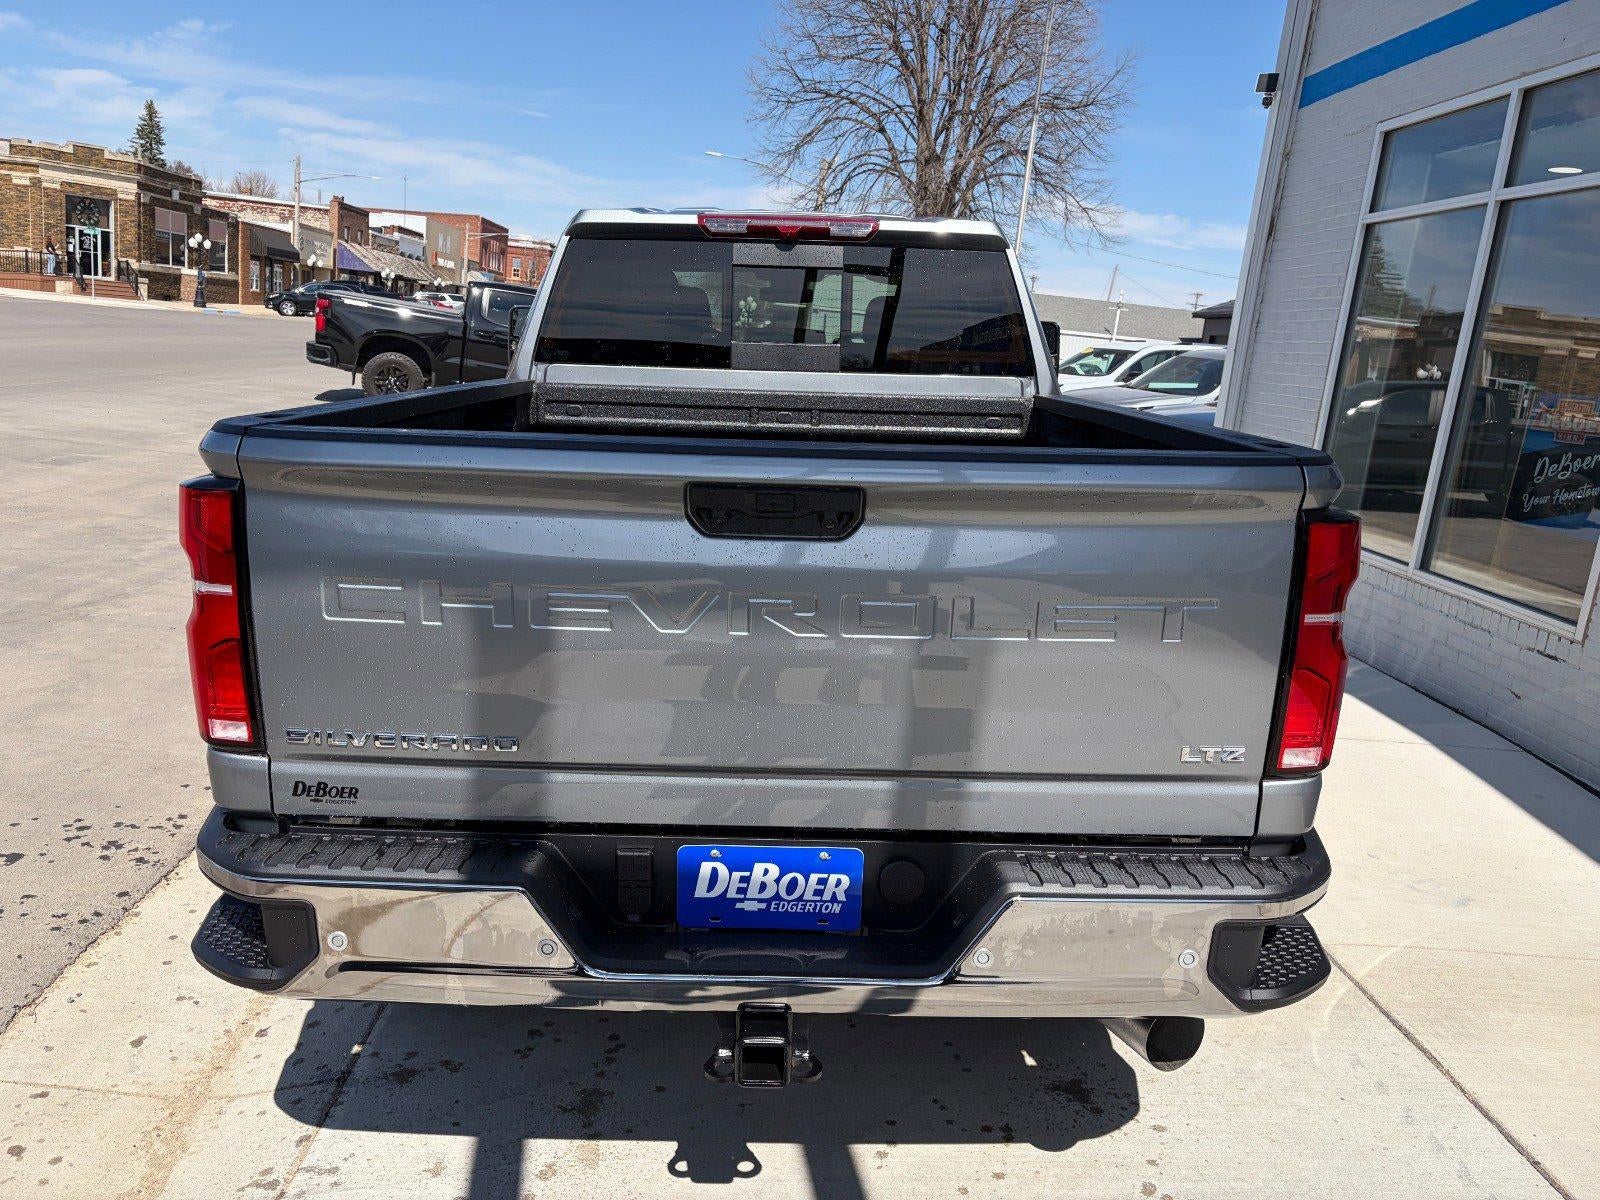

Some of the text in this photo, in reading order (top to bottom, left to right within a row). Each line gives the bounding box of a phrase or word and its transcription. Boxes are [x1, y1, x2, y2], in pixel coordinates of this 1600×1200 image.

[1534, 452, 1600, 483] DeBoer
[1522, 494, 1550, 512] Your
[320, 577, 1219, 643] CHEVROLET
[285, 728, 520, 752] SILVERADO
[1180, 745, 1246, 763] LTZ
[770, 901, 842, 914] EDGERTON
